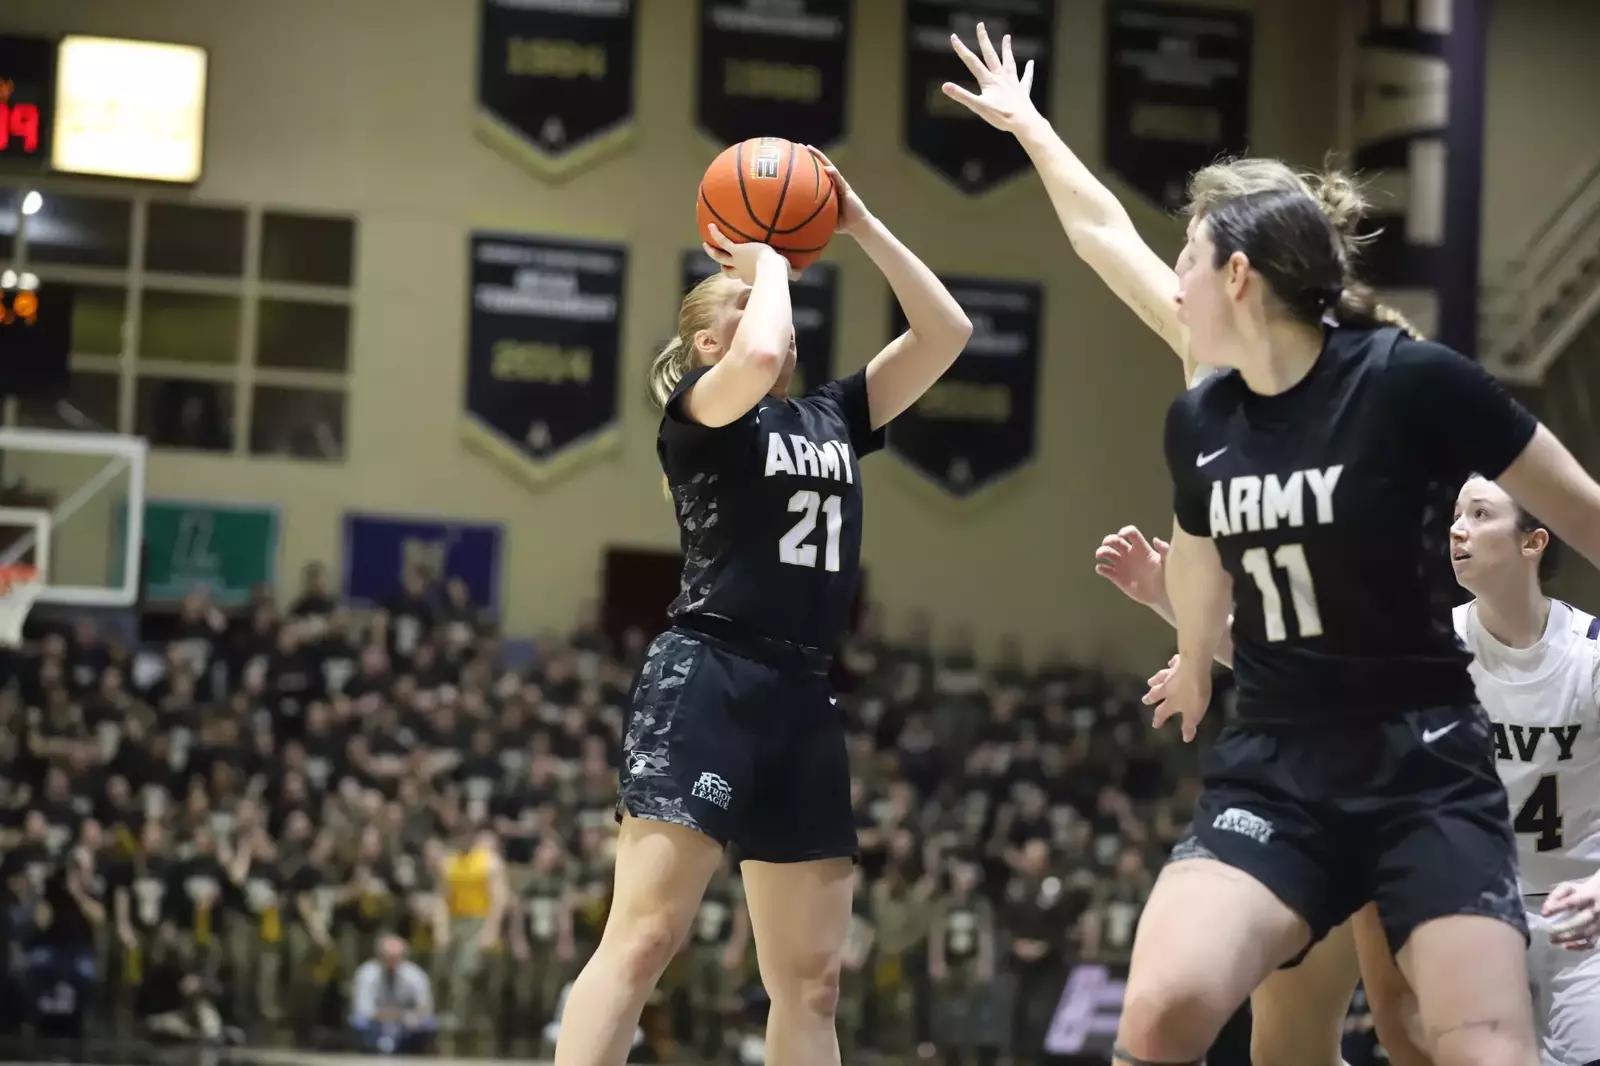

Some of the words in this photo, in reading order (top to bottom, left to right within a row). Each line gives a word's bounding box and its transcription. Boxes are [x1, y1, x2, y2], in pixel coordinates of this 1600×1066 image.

[764, 432, 853, 485] ARMY
[778, 489, 843, 572] 21
[1209, 464, 1344, 539] ARMY
[1241, 543, 1323, 642] 11
[1491, 722, 1582, 762] AVY
[691, 789, 728, 810] LEAGUE
[694, 781, 732, 803] PATRIOT
[1513, 773, 1564, 853] 4
